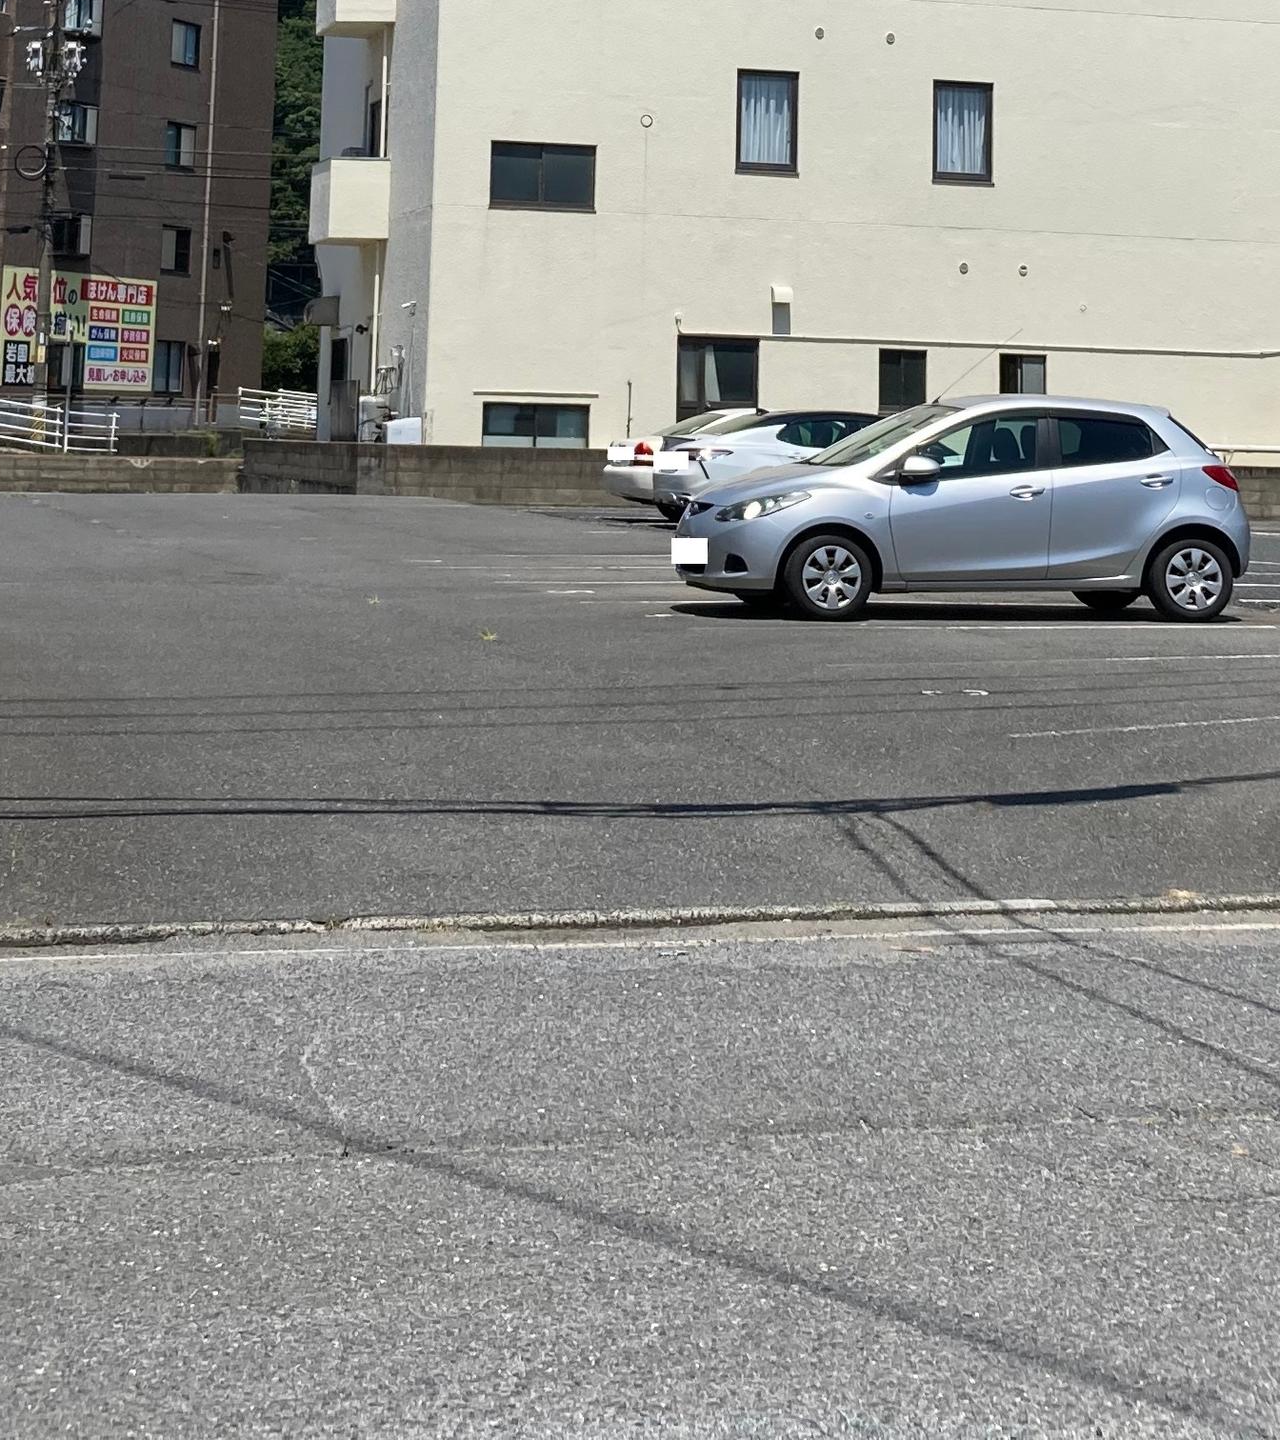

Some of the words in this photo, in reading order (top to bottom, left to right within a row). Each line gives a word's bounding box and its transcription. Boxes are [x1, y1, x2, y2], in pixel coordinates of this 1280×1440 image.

[6, 272, 39, 302] 人気
[87, 281, 148, 304] ほけん専門店
[6, 307, 38, 334] 保険
[5, 342, 29, 363] 岩国
